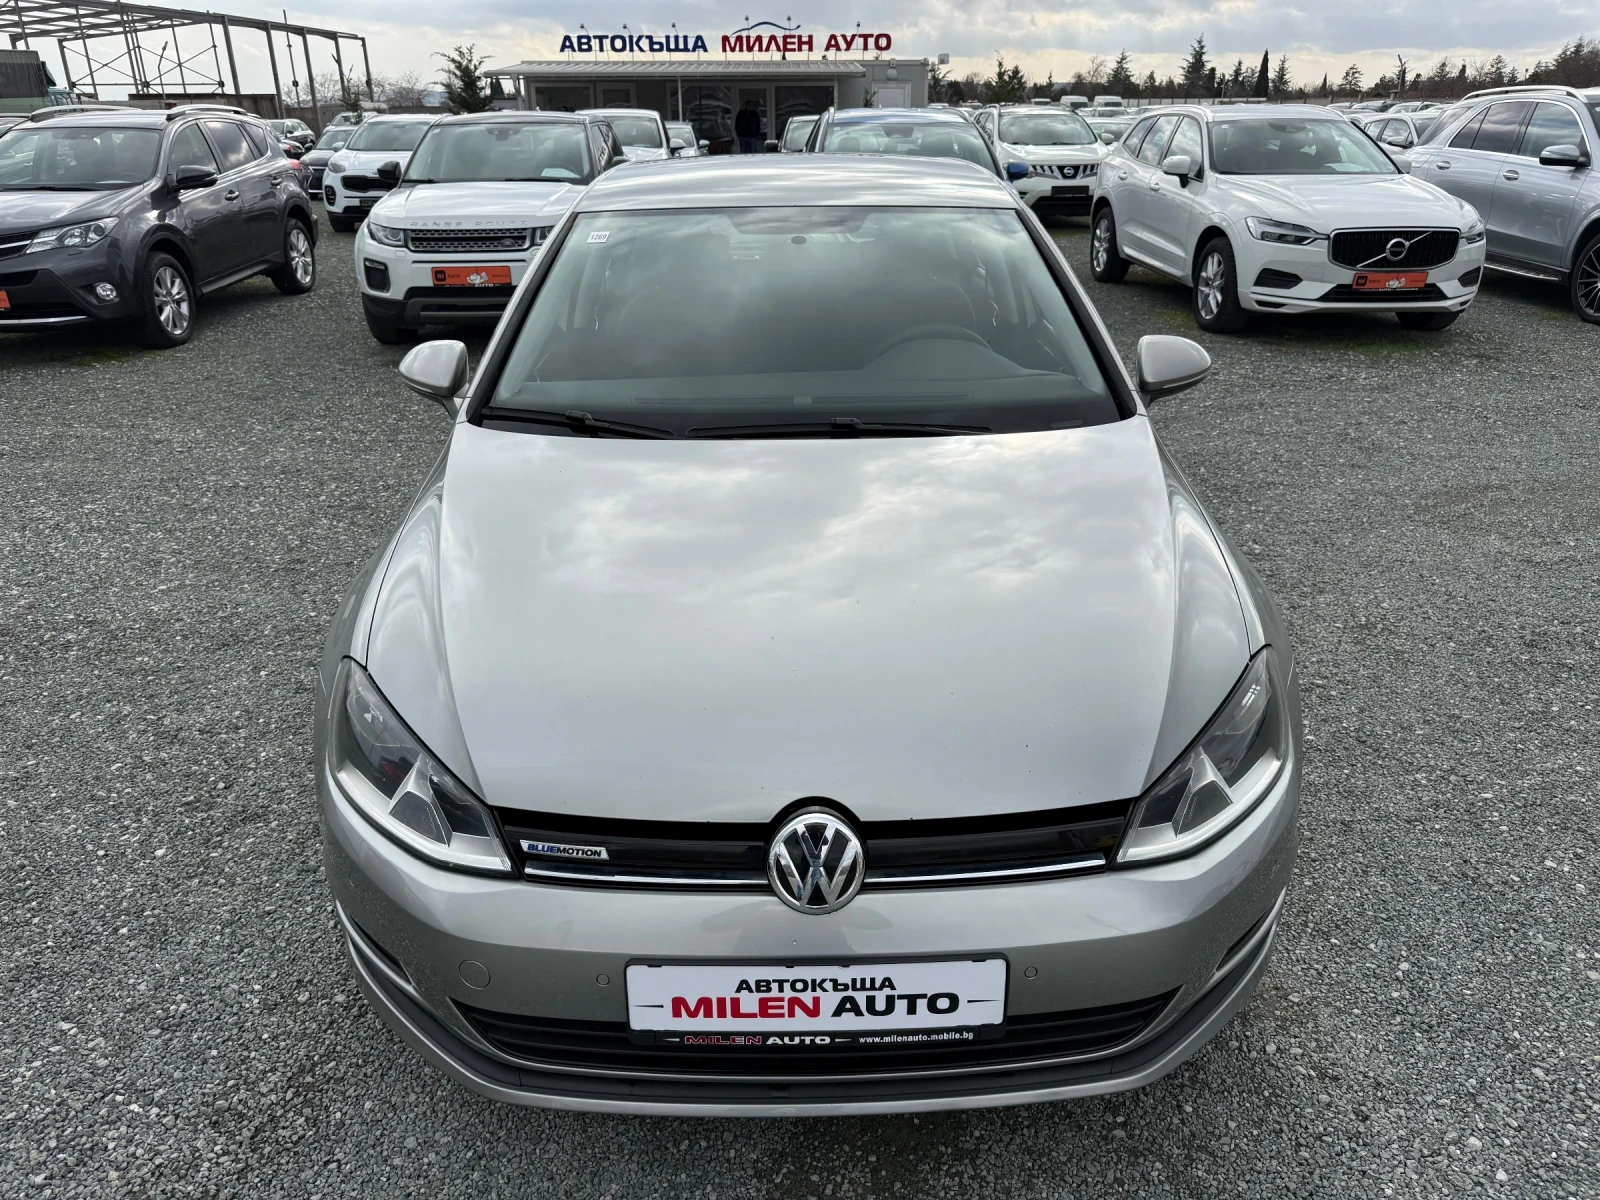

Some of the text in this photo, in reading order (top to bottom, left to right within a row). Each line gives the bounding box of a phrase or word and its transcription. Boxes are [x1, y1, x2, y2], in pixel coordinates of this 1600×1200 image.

[559, 33, 892, 53] АВТОКЪЩА МИЛЕН АУТО
[527, 843, 602, 857] BLUEMOTION
[734, 976, 897, 994] АВТОКЪЩА
[671, 992, 960, 1019] MILEN AUTO
[684, 1030, 974, 1045] MILEN AUTO www.milenauto.mobile.bg
